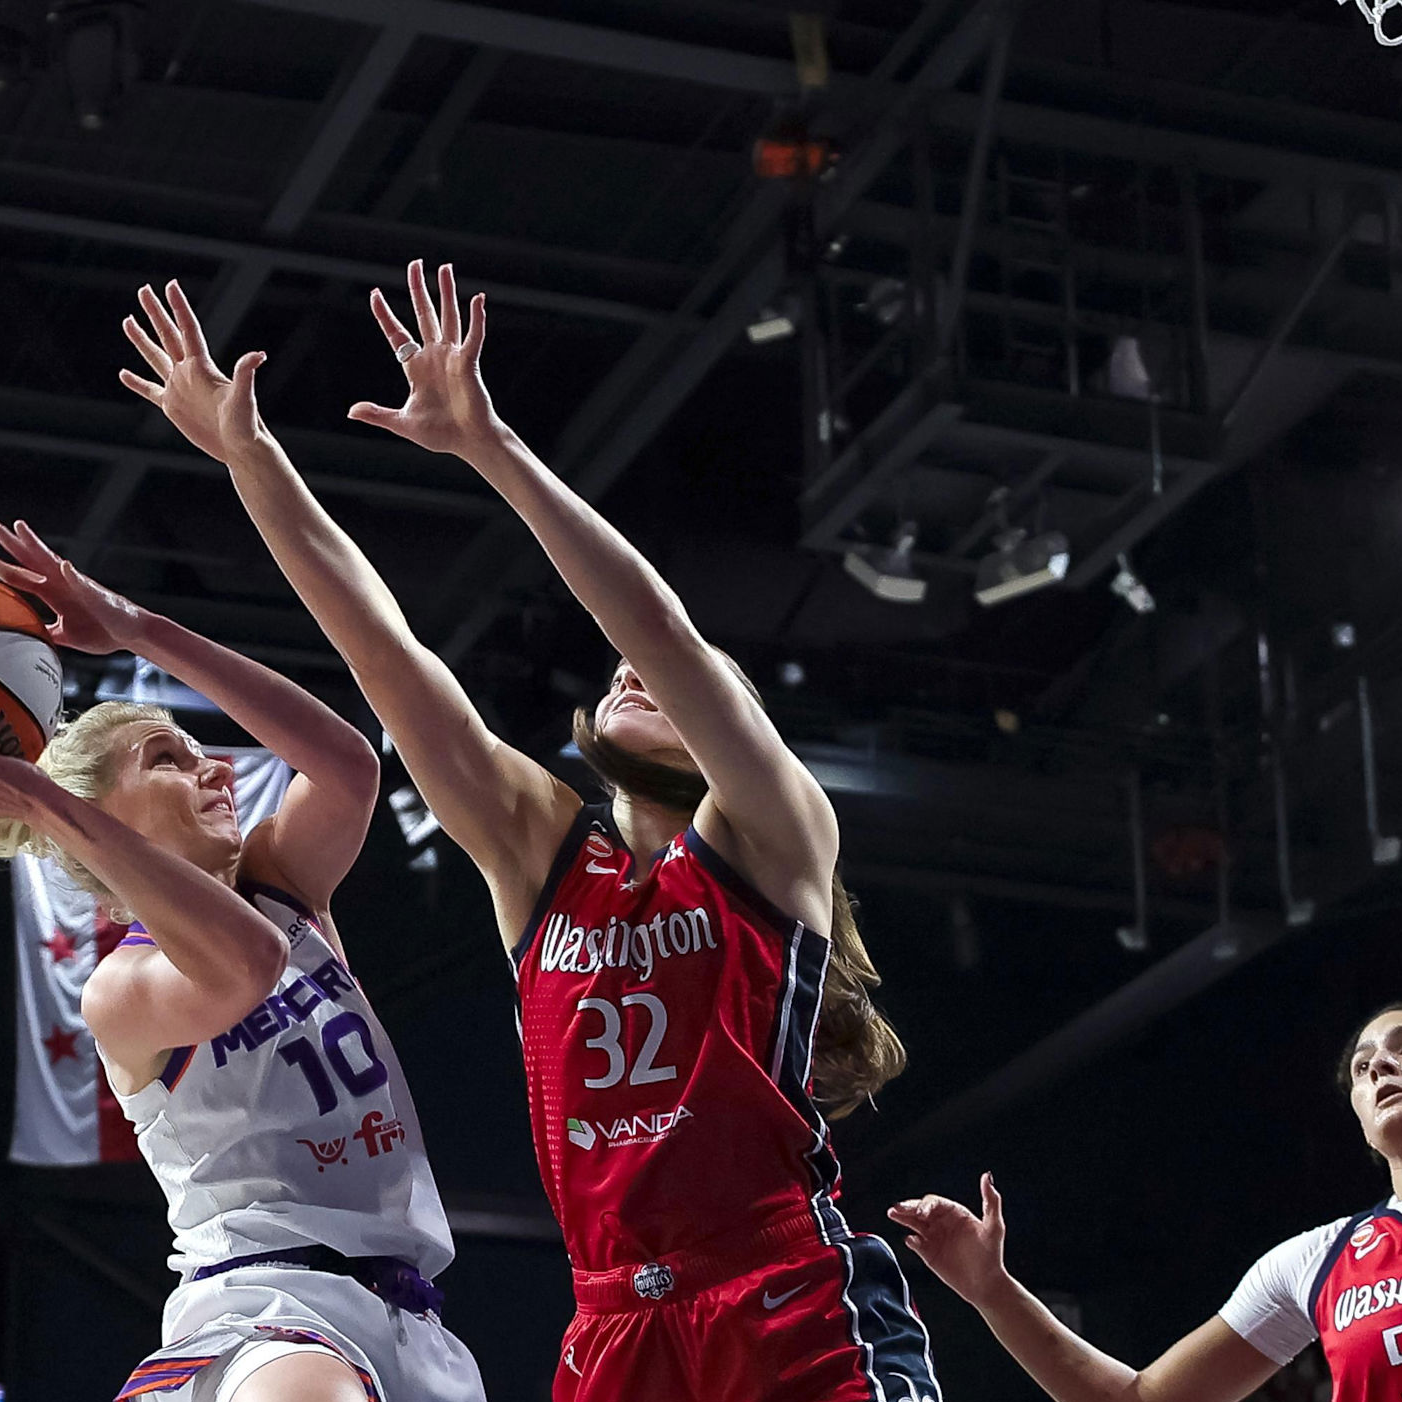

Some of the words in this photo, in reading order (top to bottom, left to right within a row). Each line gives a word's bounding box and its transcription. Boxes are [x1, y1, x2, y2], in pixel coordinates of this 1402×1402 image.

[541, 907, 718, 982] Wasington
[277, 1010, 389, 1117] 10
[576, 992, 678, 1090] 32
[595, 1105, 695, 1140] VANDA
